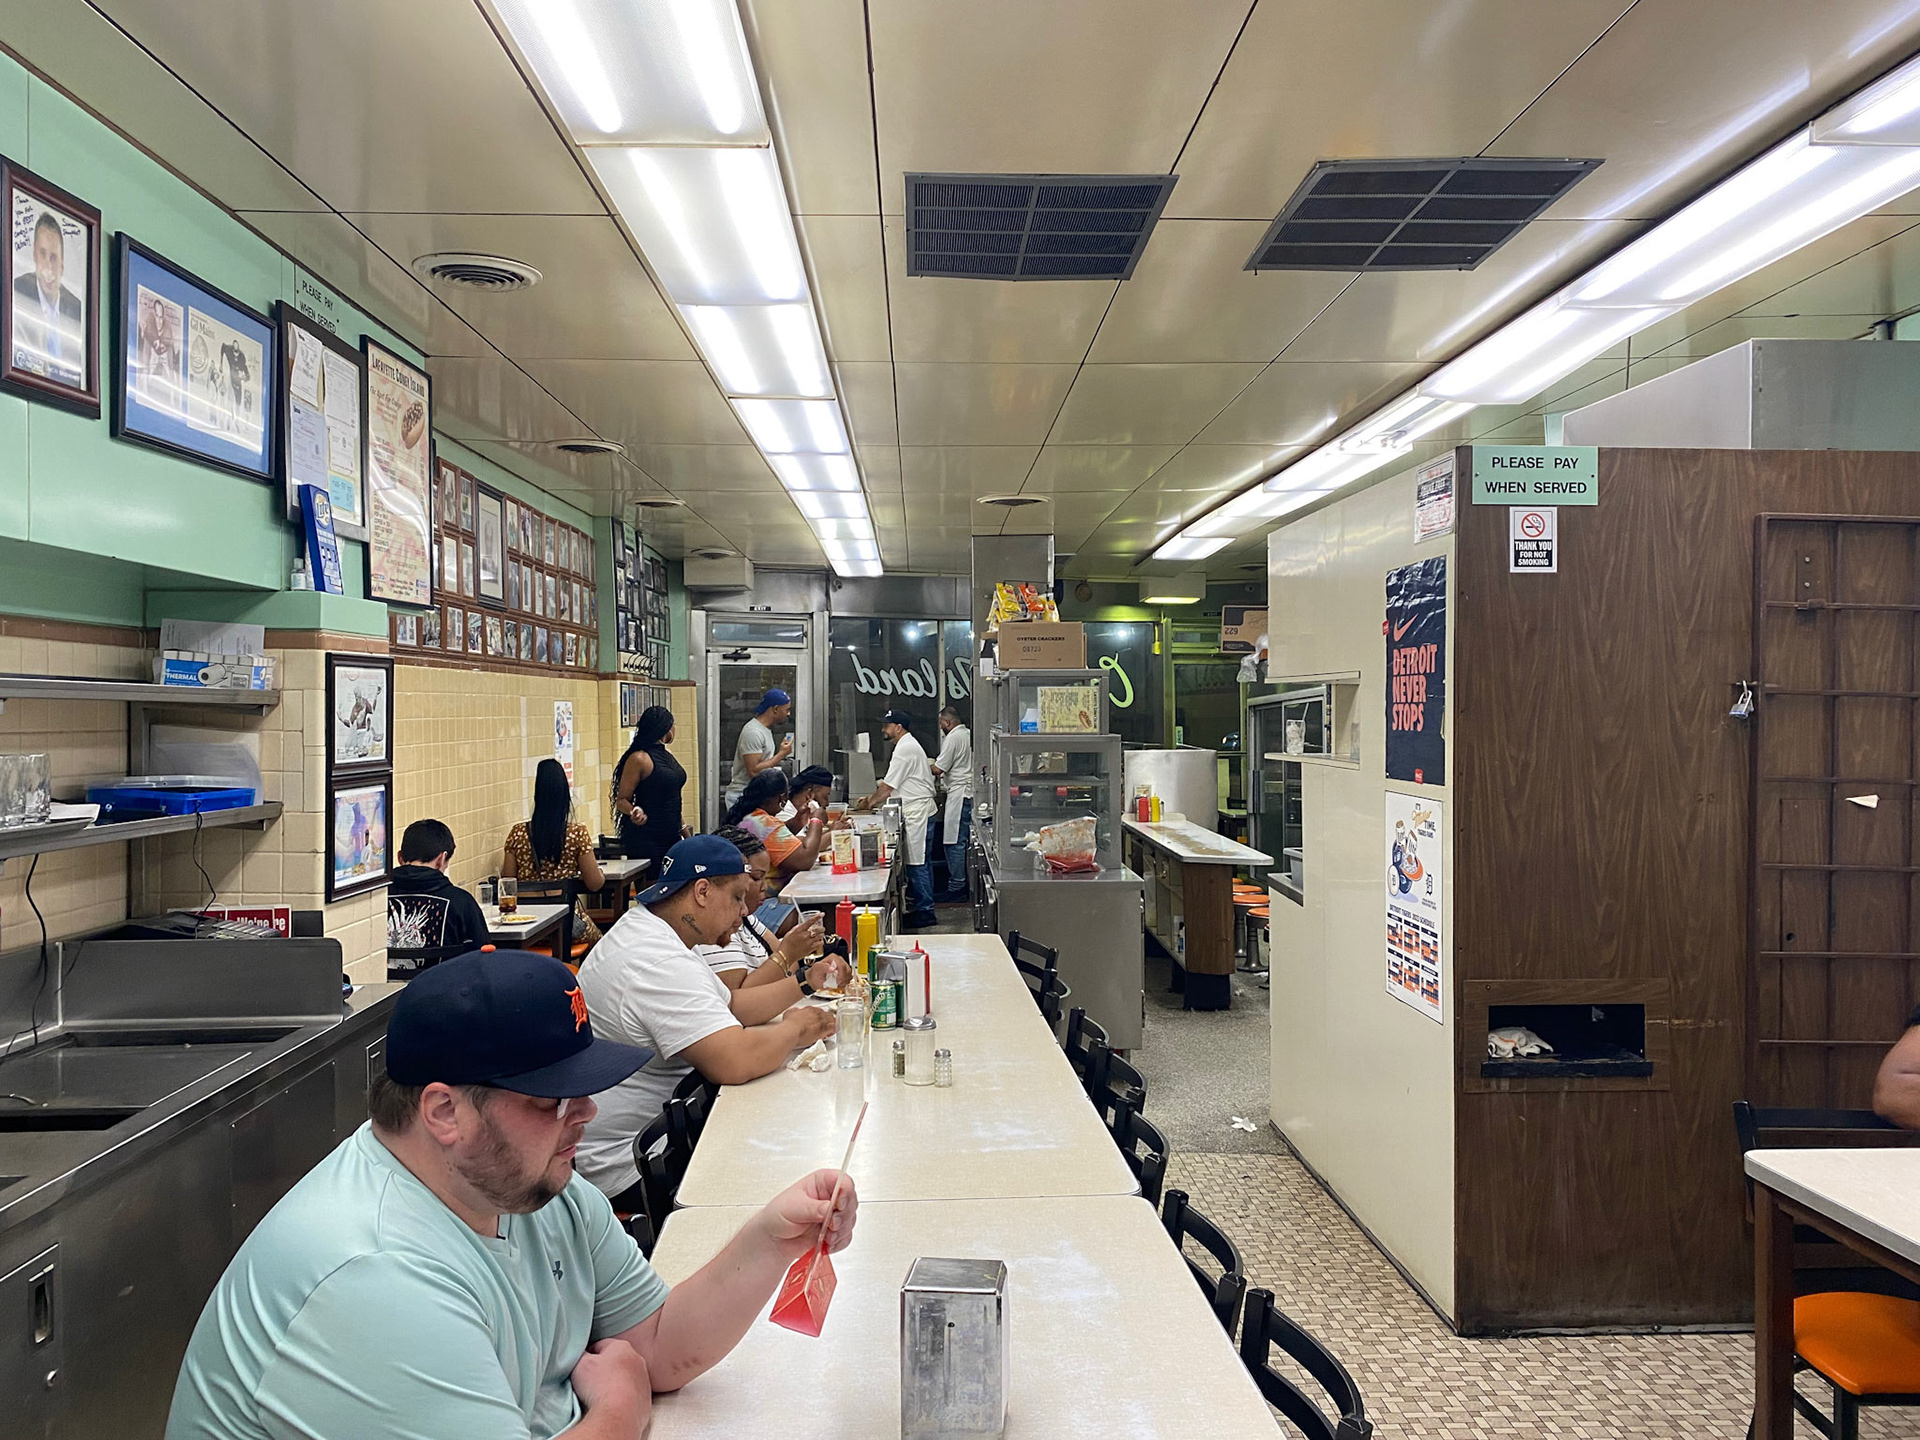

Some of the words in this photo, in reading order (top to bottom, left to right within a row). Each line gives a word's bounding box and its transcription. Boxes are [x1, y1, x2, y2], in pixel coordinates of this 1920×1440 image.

[302, 280, 322, 303] PLEASE
[324, 296, 334, 311] PAY
[300, 301, 316, 320] WHEN
[317, 313, 337, 334] SERVED
[372, 353, 396, 380] LAFAYETTE
[395, 367, 410, 389] CONEY
[410, 376, 425, 397] ISLAND
[1492, 456, 1545, 469] PLEASE
[1554, 457, 1579, 469] PAY
[1485, 481, 1527, 493] WHEN
[1533, 481, 1587, 493] SERVED
[1514, 541, 1538, 550] THANK
[1538, 541, 1552, 550] YOU
[1517, 558, 1549, 566] SMOKING
[1225, 627, 1239, 635] 622
[1392, 643, 1438, 676] DETROIT
[166, 672, 198, 681] THERMAL
[1392, 674, 1427, 703] NEVER
[1391, 703, 1425, 732] STOPS
